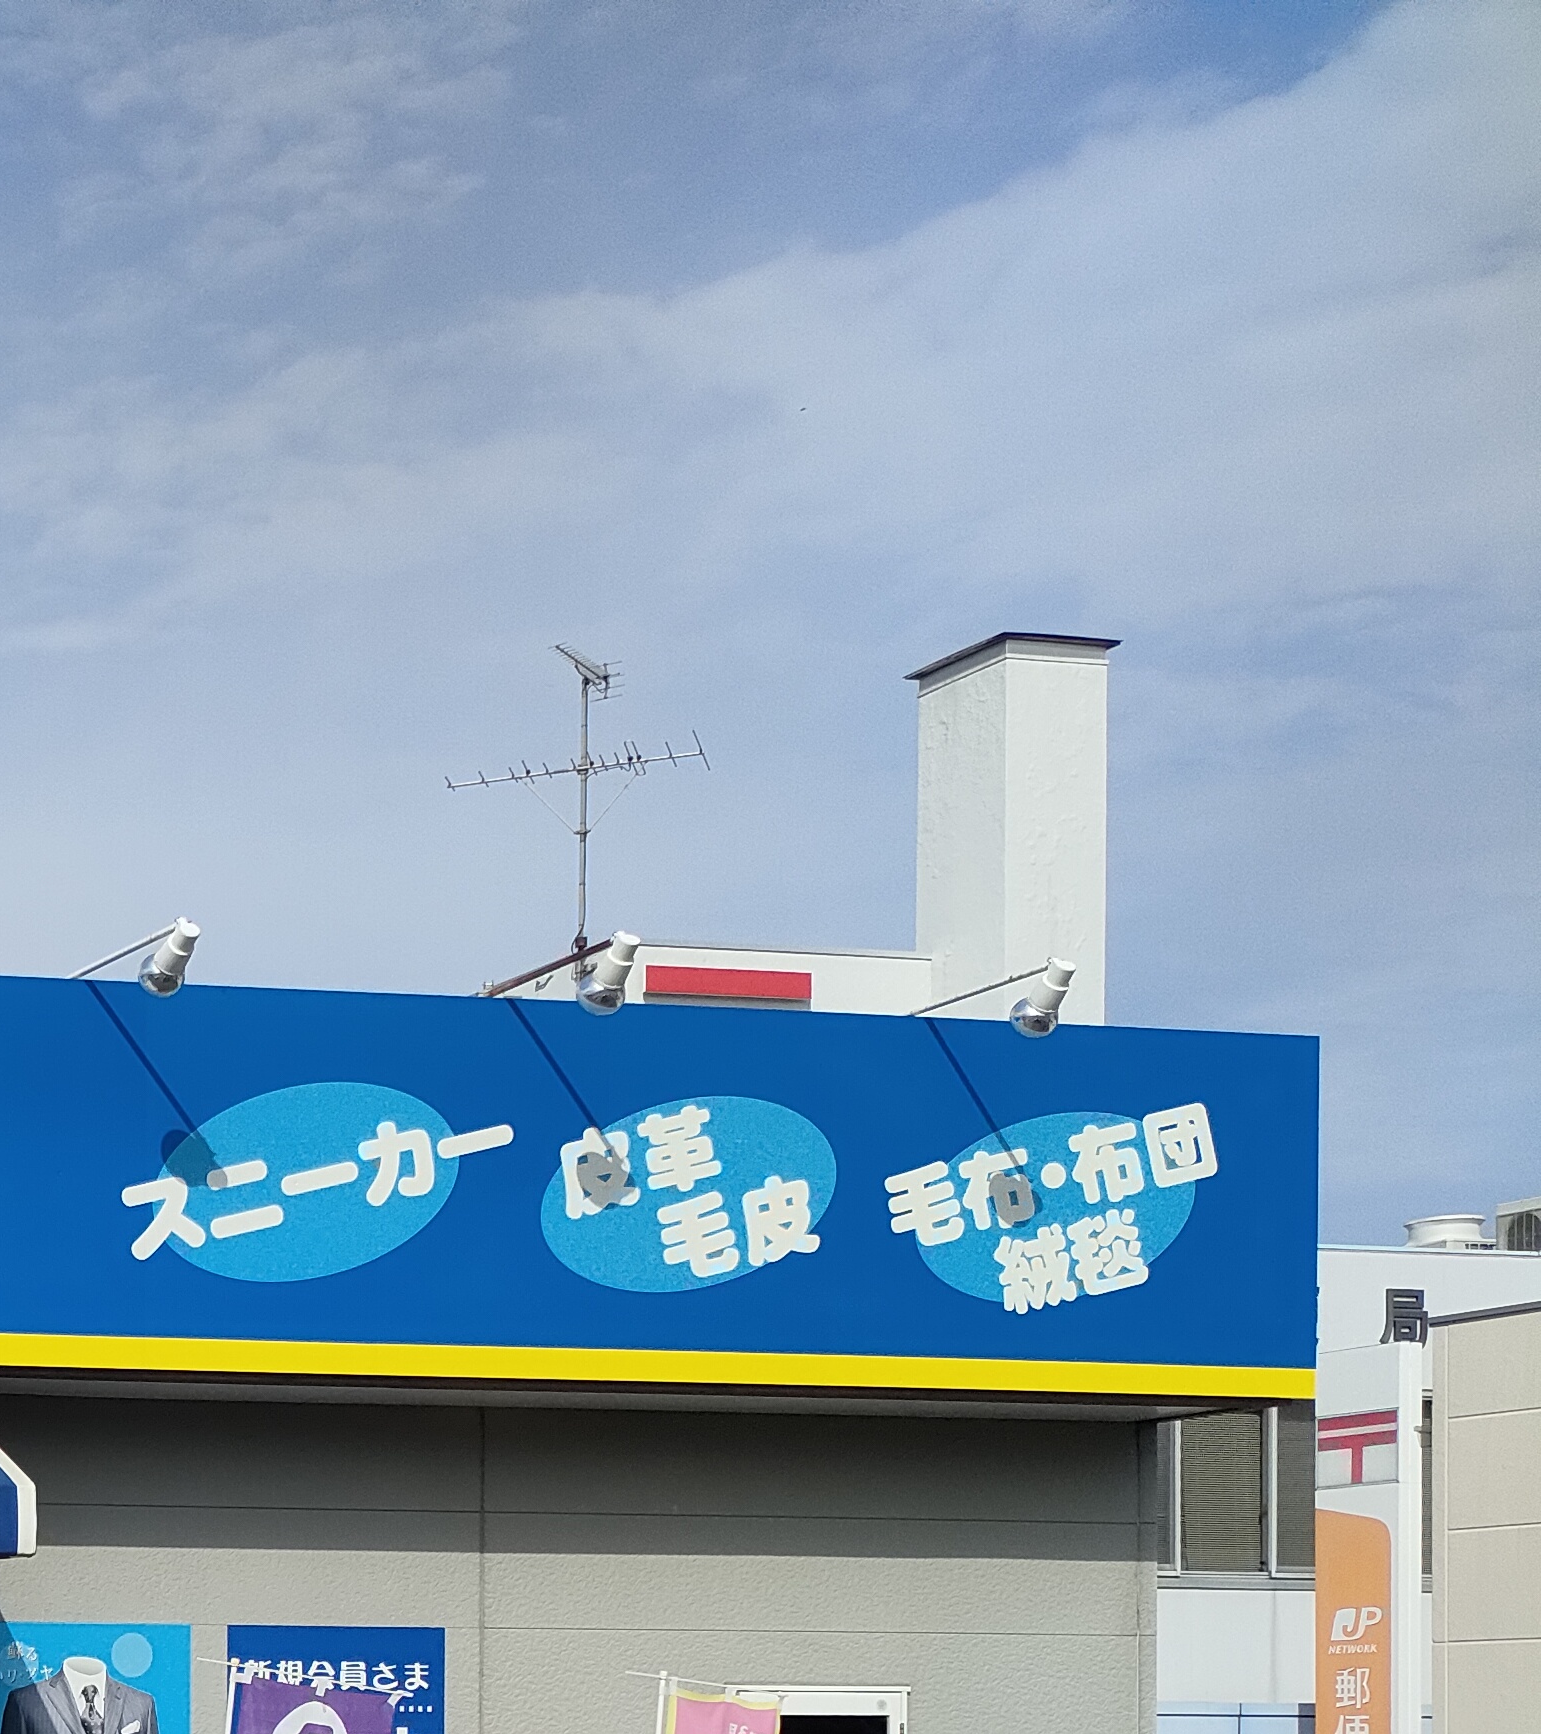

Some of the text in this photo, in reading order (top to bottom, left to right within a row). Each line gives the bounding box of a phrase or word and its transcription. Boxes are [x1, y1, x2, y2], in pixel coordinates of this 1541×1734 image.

[121, 1121, 514, 1261] スニーカー
[561, 1105, 722, 1219] 皮革
[884, 1102, 1218, 1249] 毛布・布団
[658, 1177, 821, 1278] 毛皮
[994, 1209, 1149, 1315] 絨毯
[1379, 1288, 1428, 1349] 局
[1328, 1643, 1378, 1655] NETWORK
